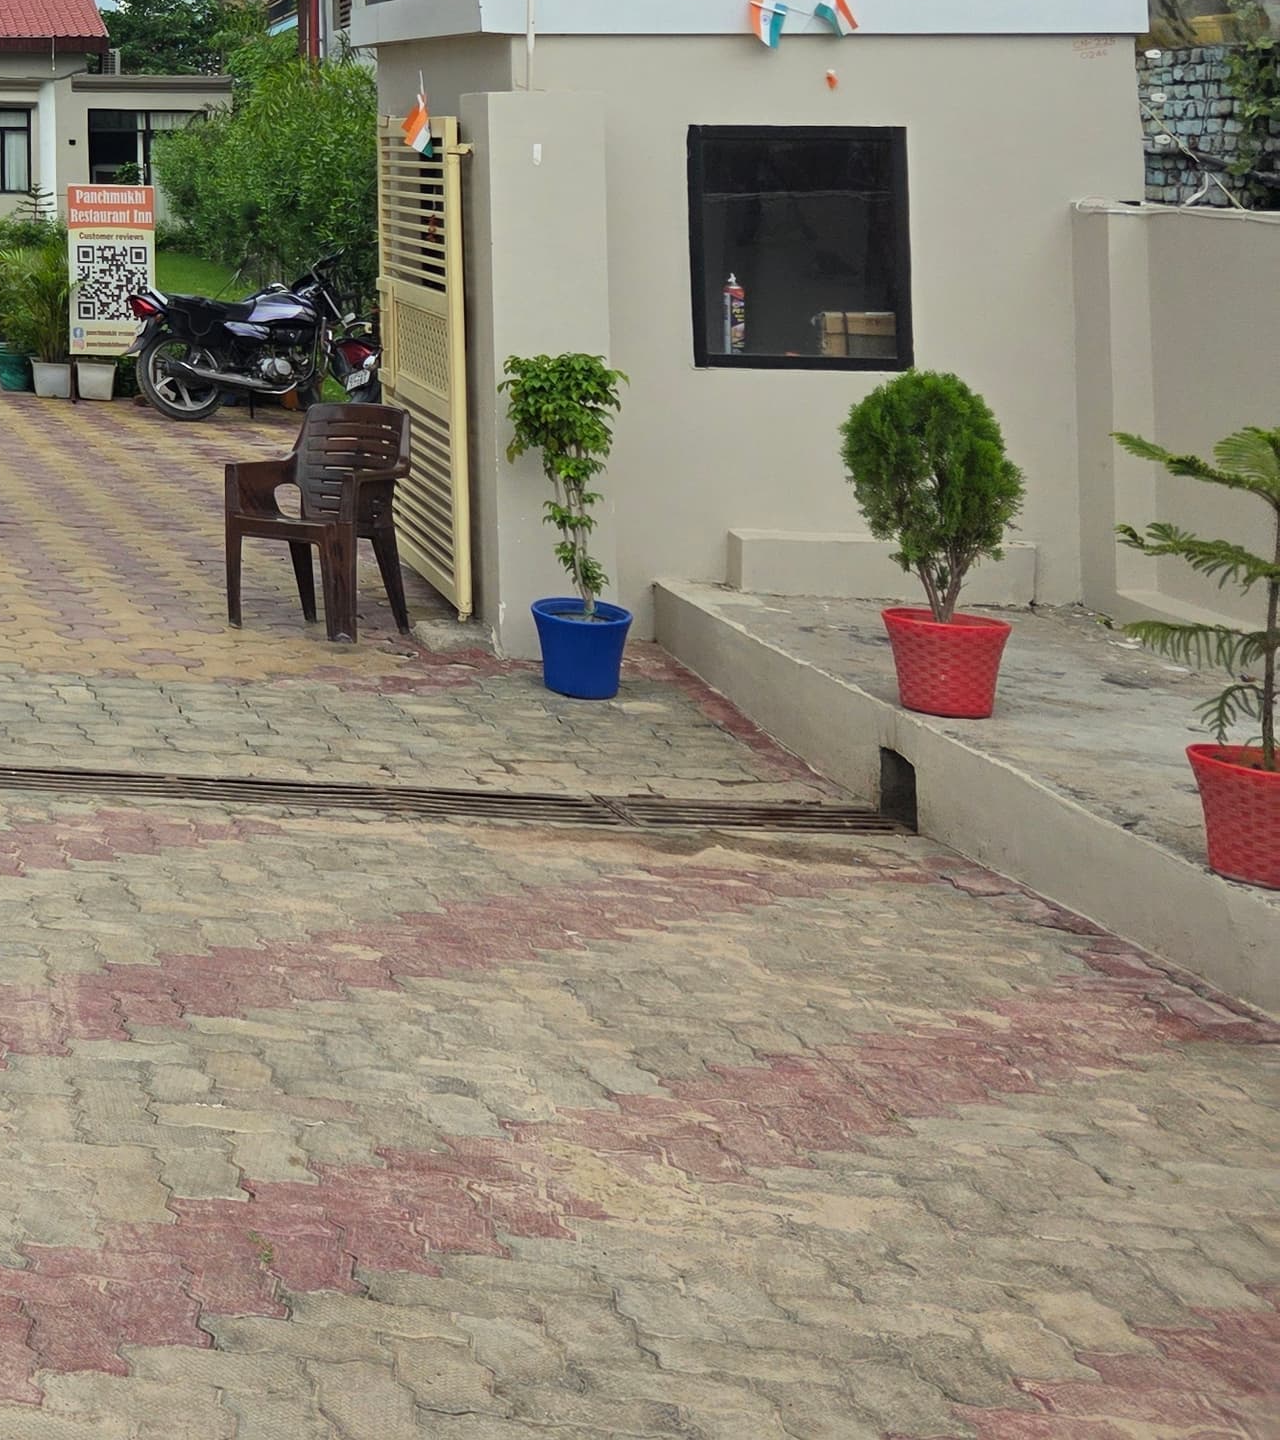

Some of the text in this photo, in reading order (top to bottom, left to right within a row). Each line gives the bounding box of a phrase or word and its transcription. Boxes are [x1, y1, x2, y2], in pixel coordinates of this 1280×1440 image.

[75, 189, 146, 205] Panchmukhi
[70, 208, 153, 224] Restaurant Inn
[79, 232, 145, 241] Customer reviews
